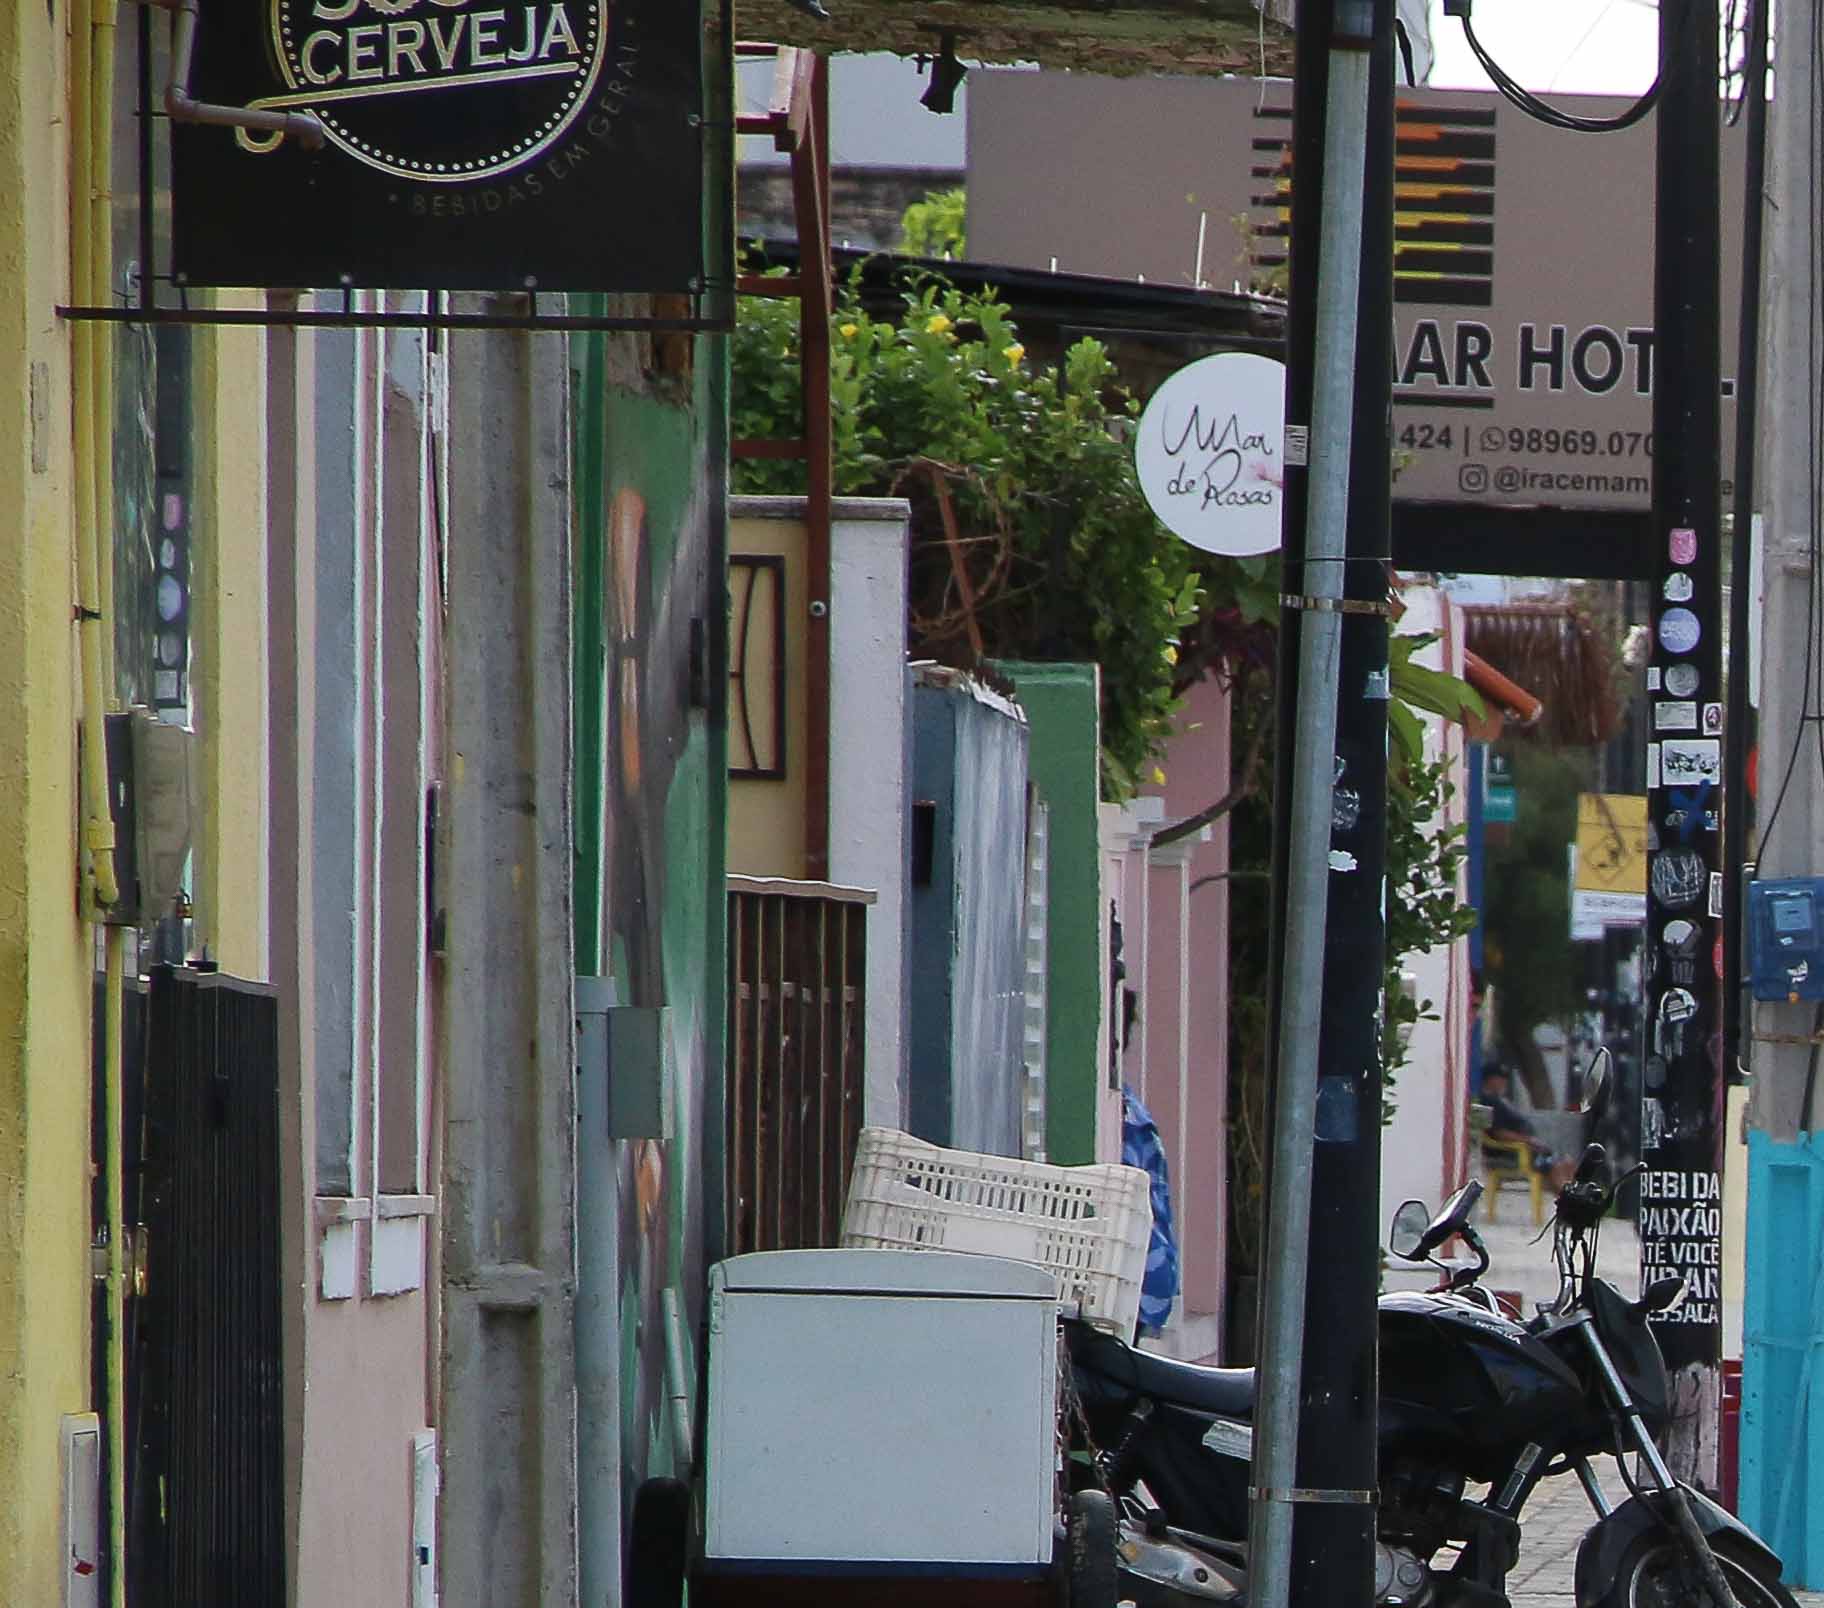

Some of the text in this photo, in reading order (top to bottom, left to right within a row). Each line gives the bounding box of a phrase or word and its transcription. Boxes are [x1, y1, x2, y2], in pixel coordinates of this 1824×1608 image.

[301, 2, 581, 85] CERVEJA
[411, 174, 544, 216] BEBIDAS
[1392, 319, 1495, 388] AR
[1391, 424, 1655, 457] 424 98969.070
[1168, 449, 1272, 510] de Rosas
[1671, 1237, 1720, 1266] VOCÊ
